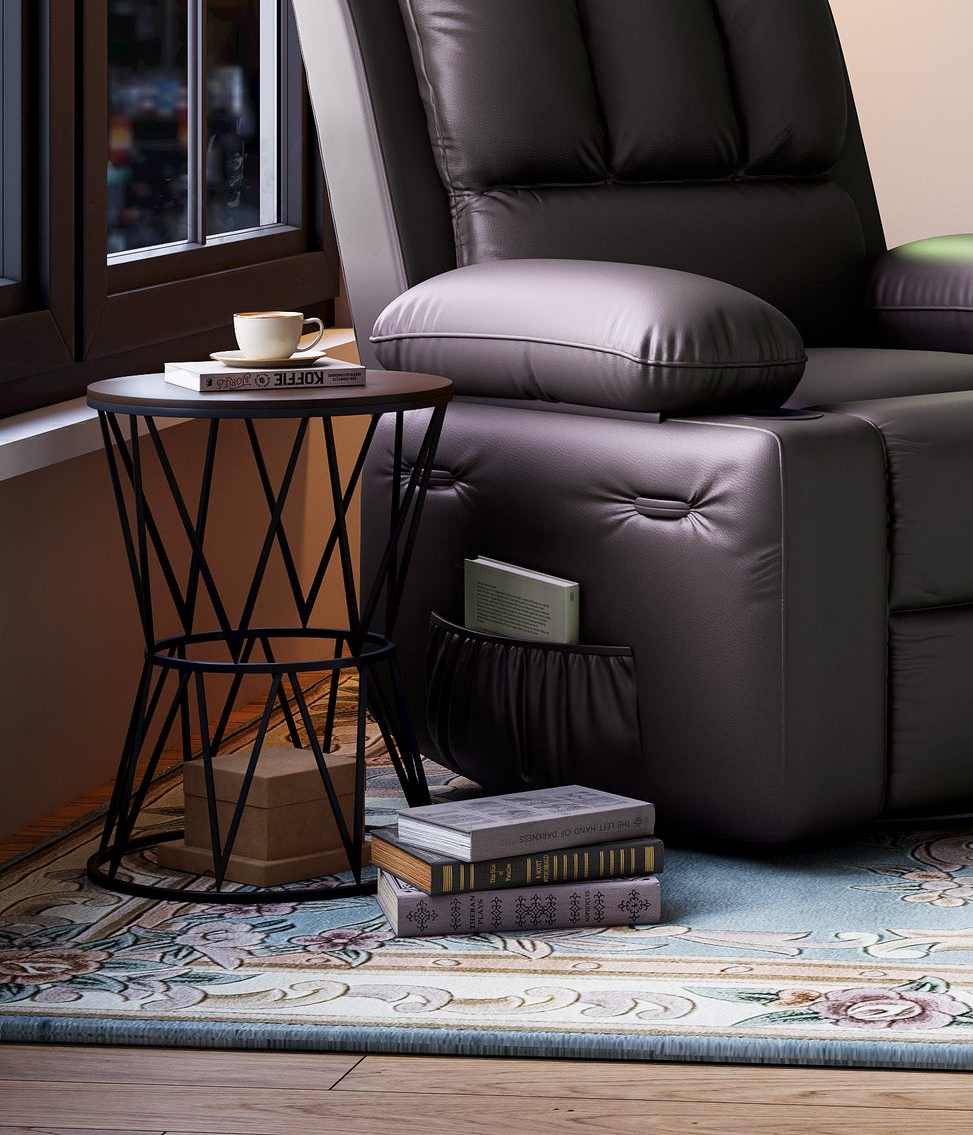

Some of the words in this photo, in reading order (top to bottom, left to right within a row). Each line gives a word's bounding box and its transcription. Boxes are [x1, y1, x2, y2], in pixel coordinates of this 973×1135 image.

[274, 372, 324, 386] KOFFIE
[600, 823, 616, 832] LEFT
[618, 820, 630, 829] THE
[560, 829, 572, 838] OF
[574, 826, 596, 835] HAND
[519, 831, 558, 843] DARKNESS
